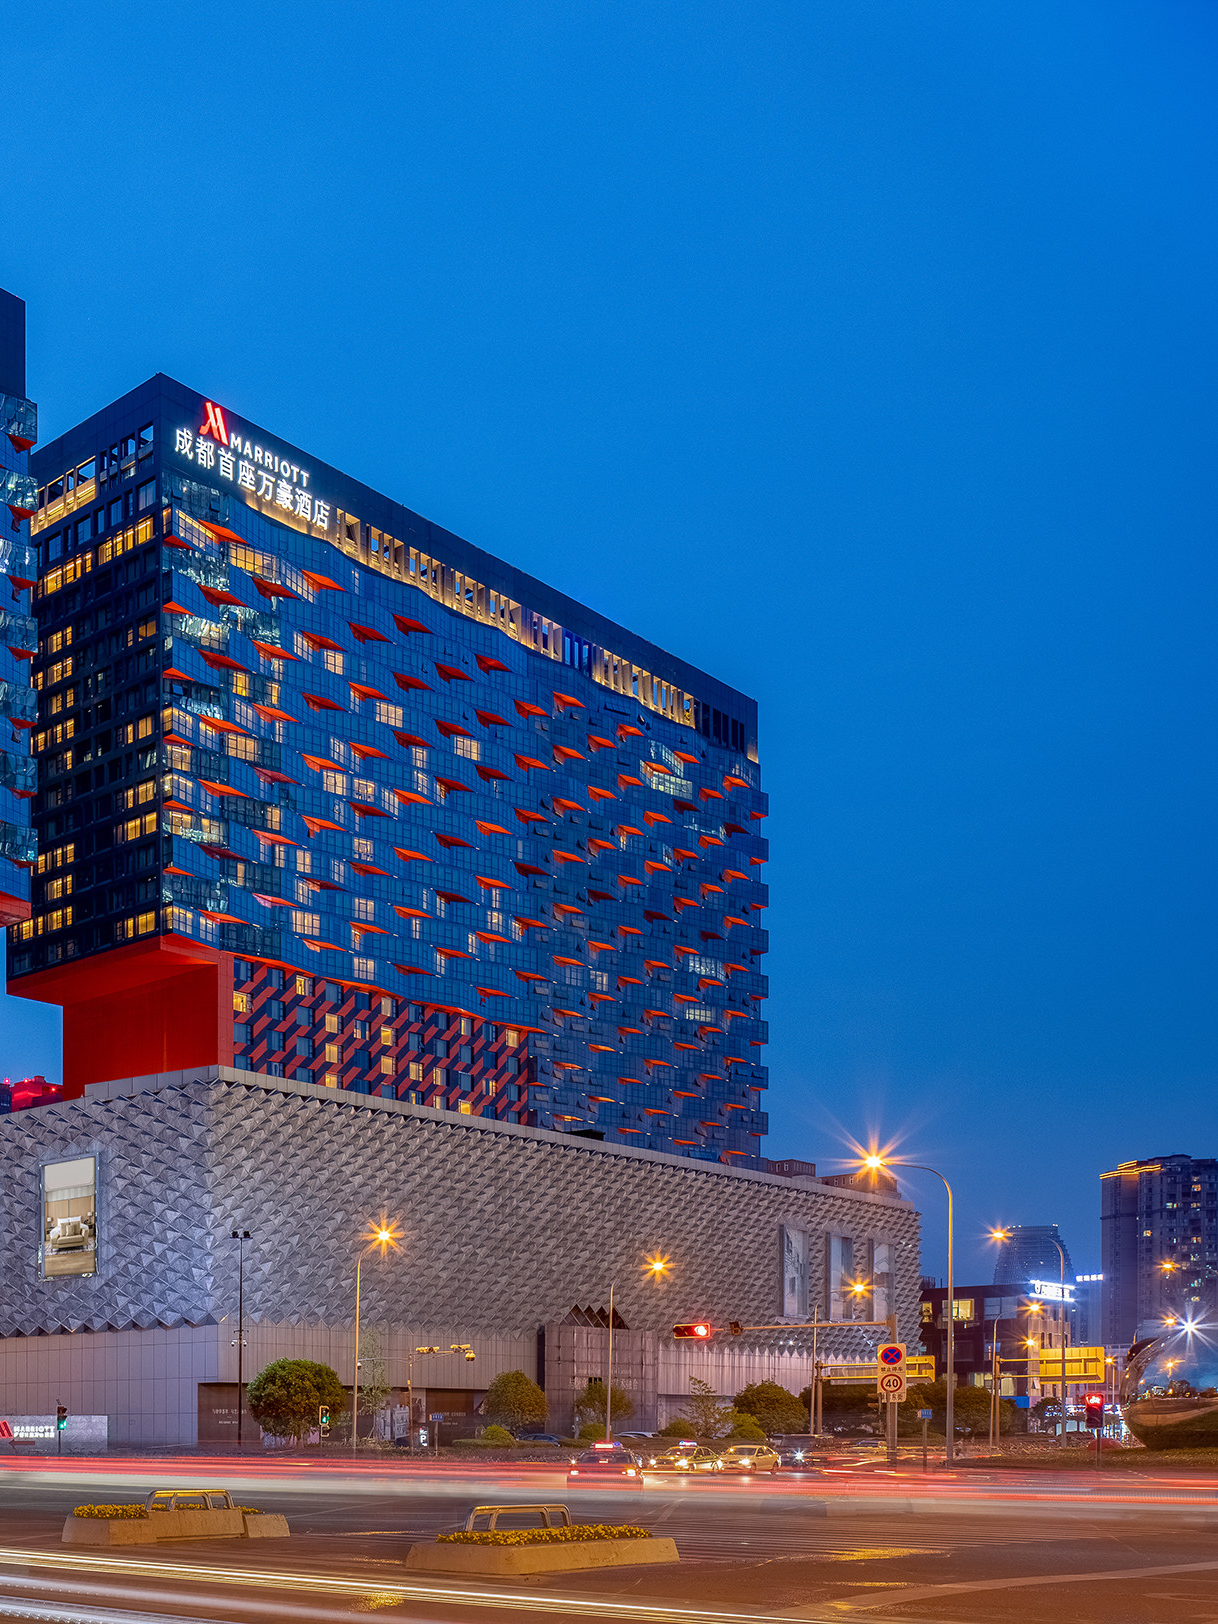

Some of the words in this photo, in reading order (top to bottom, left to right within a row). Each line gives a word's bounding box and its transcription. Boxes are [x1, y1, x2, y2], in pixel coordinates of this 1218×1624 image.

[175, 428, 331, 531] 成都首座万豪酒店
[230, 432, 310, 488] MARRIOTT
[885, 1379, 899, 1388] 40
